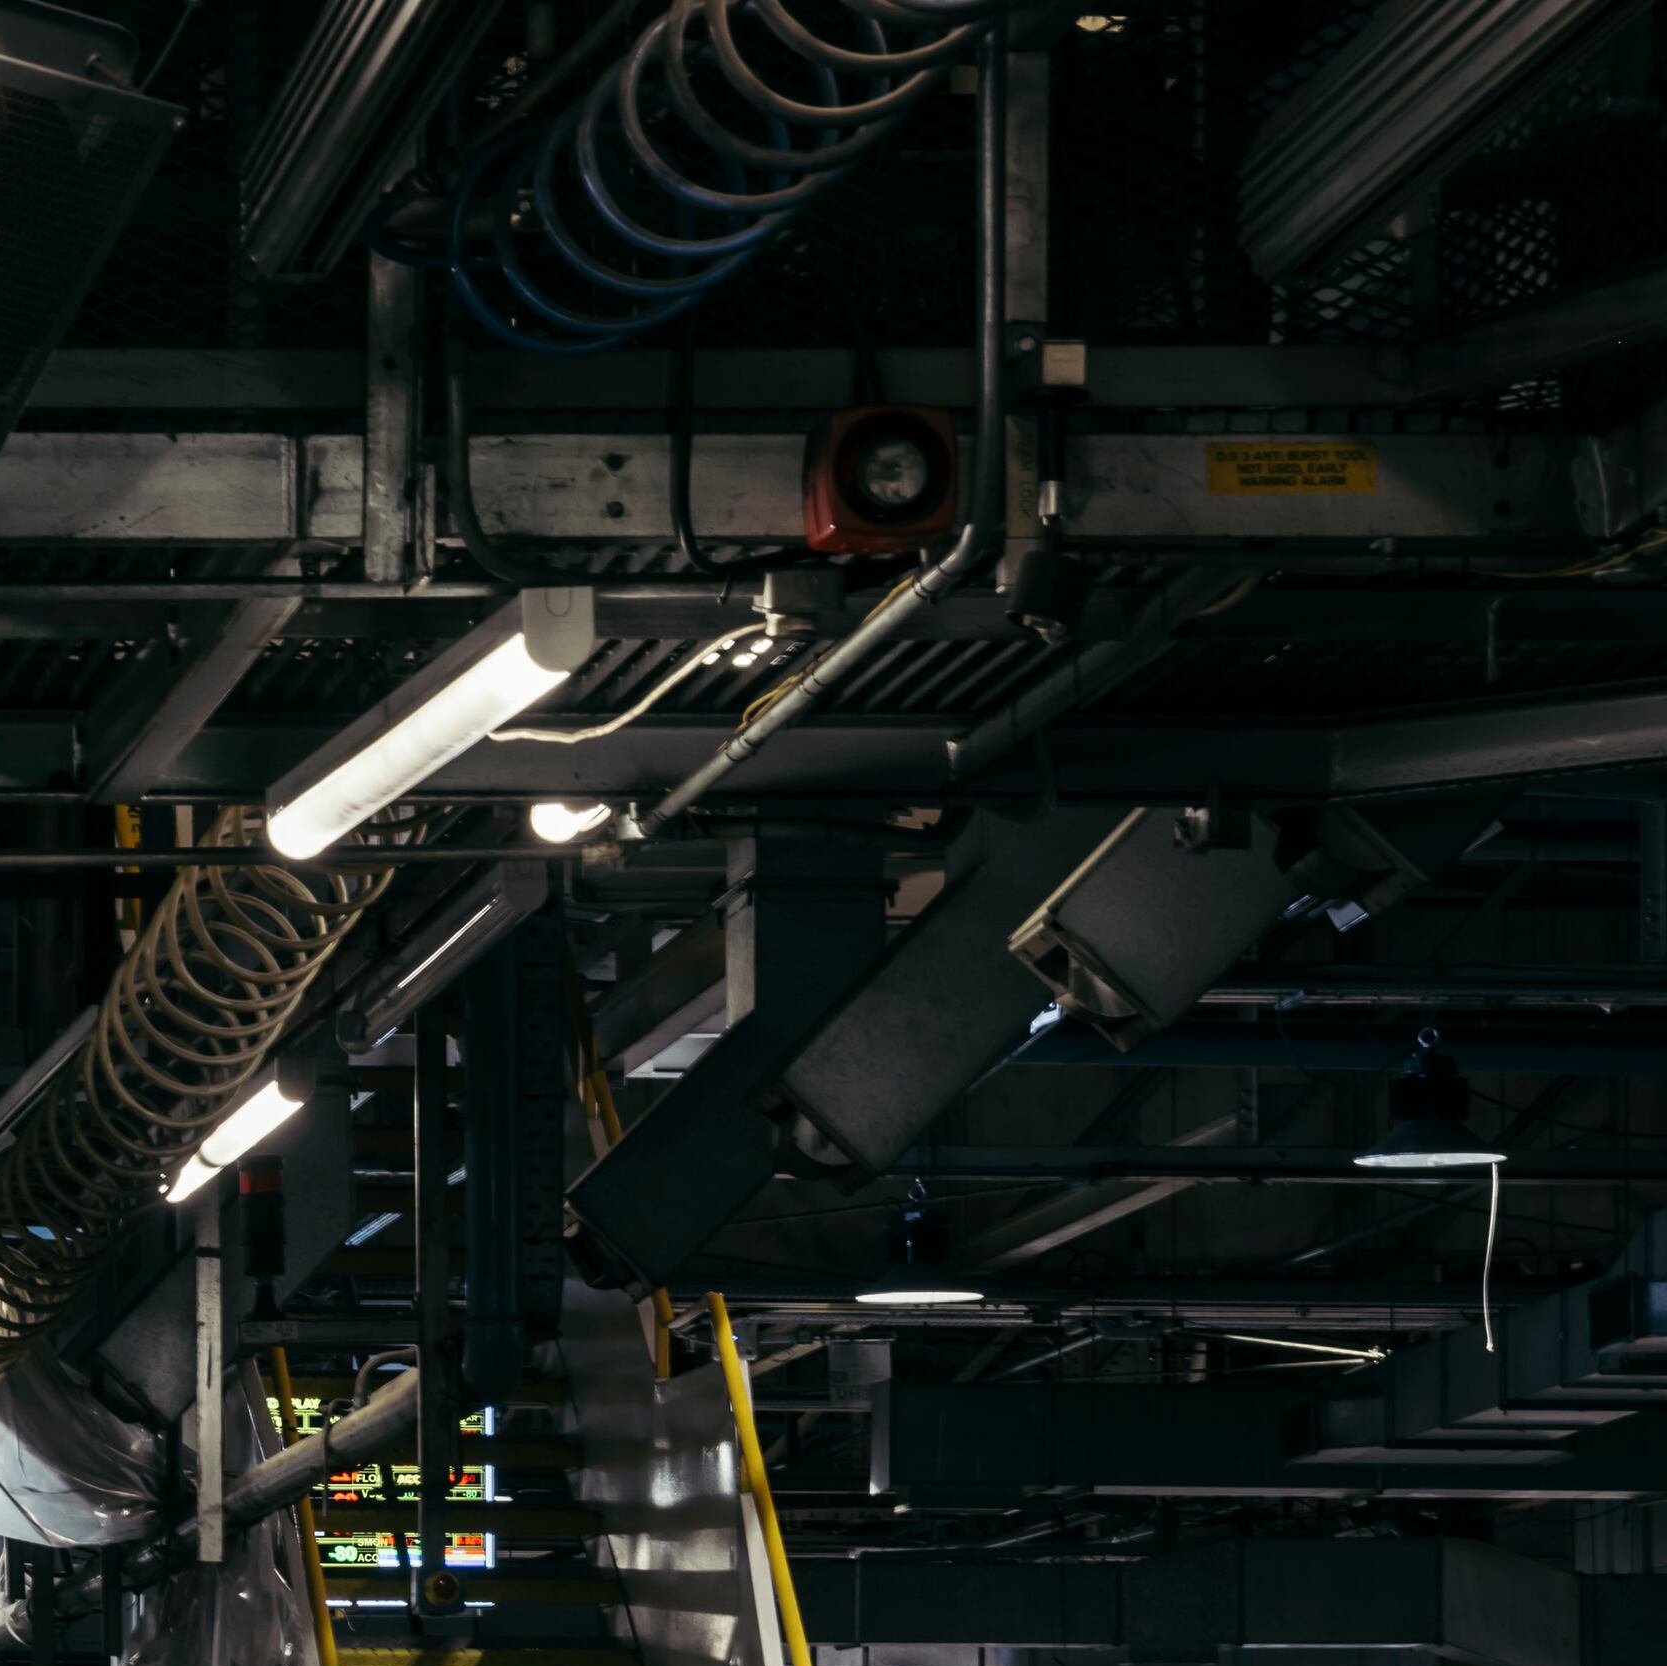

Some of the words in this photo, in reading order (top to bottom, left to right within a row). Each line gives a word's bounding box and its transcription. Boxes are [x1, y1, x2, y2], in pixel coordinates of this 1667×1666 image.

[1236, 464, 1262, 473] NOT
[1307, 463, 1346, 473] EARLY
[1238, 476, 1296, 486] WARNING
[1301, 476, 1345, 486] ALARM
